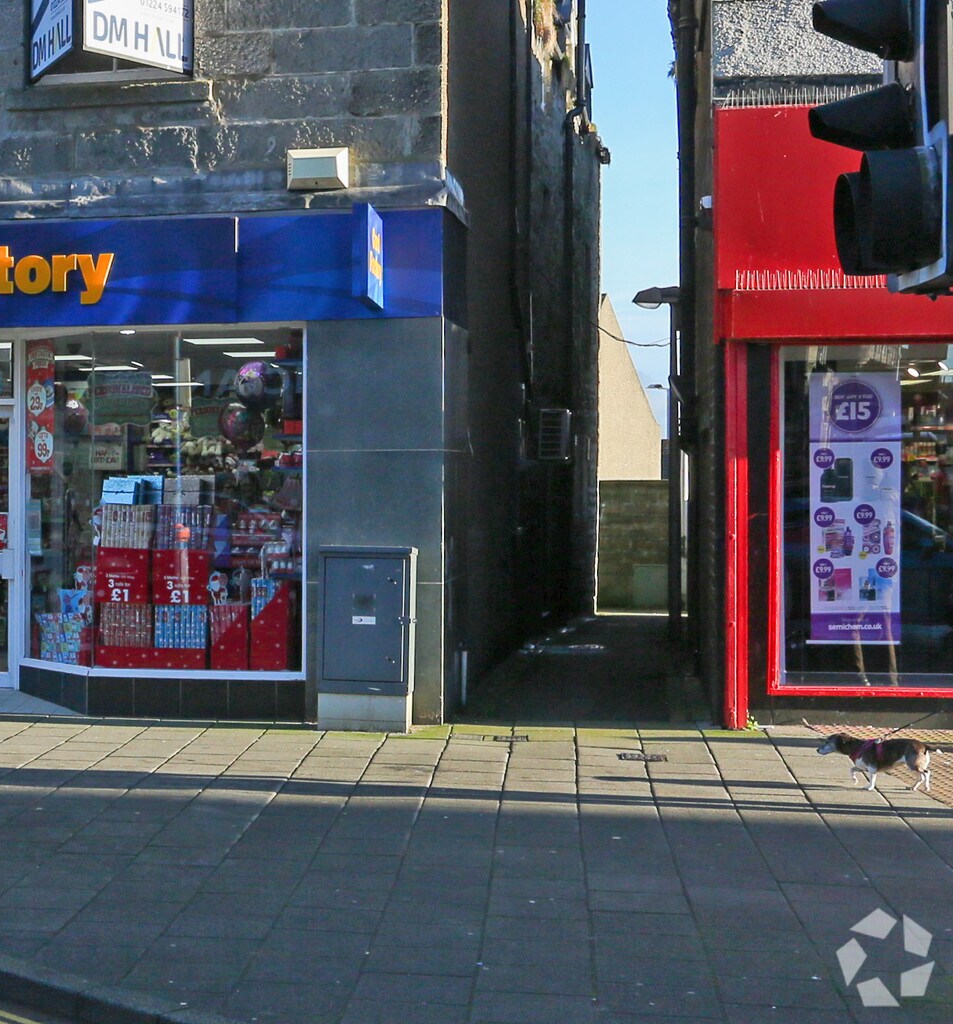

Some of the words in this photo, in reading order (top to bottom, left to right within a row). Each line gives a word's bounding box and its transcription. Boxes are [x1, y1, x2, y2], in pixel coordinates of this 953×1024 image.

[93, 10, 128, 48] DM
[32, 34, 46, 70] DM
[836, 401, 871, 421] £15
[108, 579, 115, 588] 3
[166, 581, 173, 590] 3
[111, 588, 128, 602] £1
[170, 590, 189, 603] £1
[828, 622, 883, 631] semichem.co.uk
